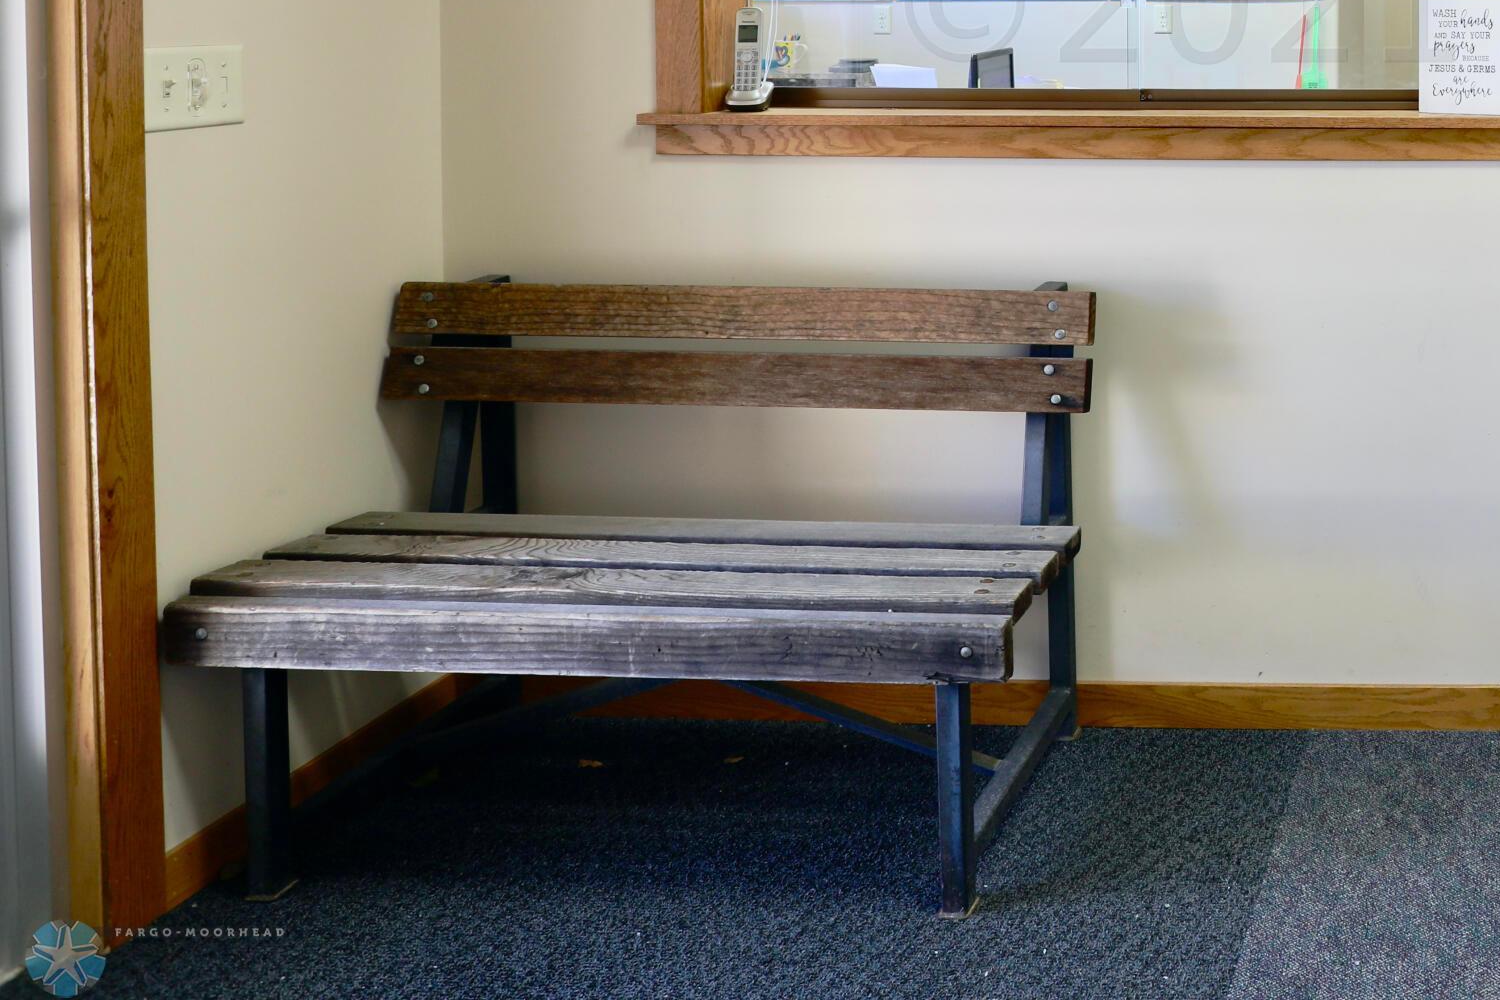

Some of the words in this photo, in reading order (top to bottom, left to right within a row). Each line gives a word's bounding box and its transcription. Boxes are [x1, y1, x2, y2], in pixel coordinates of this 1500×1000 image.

[1432, 9, 1457, 18] WASH
[1438, 20, 1458, 28] YOUR
[1460, 8, 1494, 30] hands
[1450, 31, 1466, 39] SAY
[1470, 31, 1491, 40] YOUR
[1433, 40, 1475, 60] prayers
[1428, 64, 1456, 73] JESUS
[1458, 65, 1465, 73] &
[1466, 65, 1496, 74] GERMS
[1453, 75, 1469, 85] are
[1432, 81, 1493, 106] Everywhere
